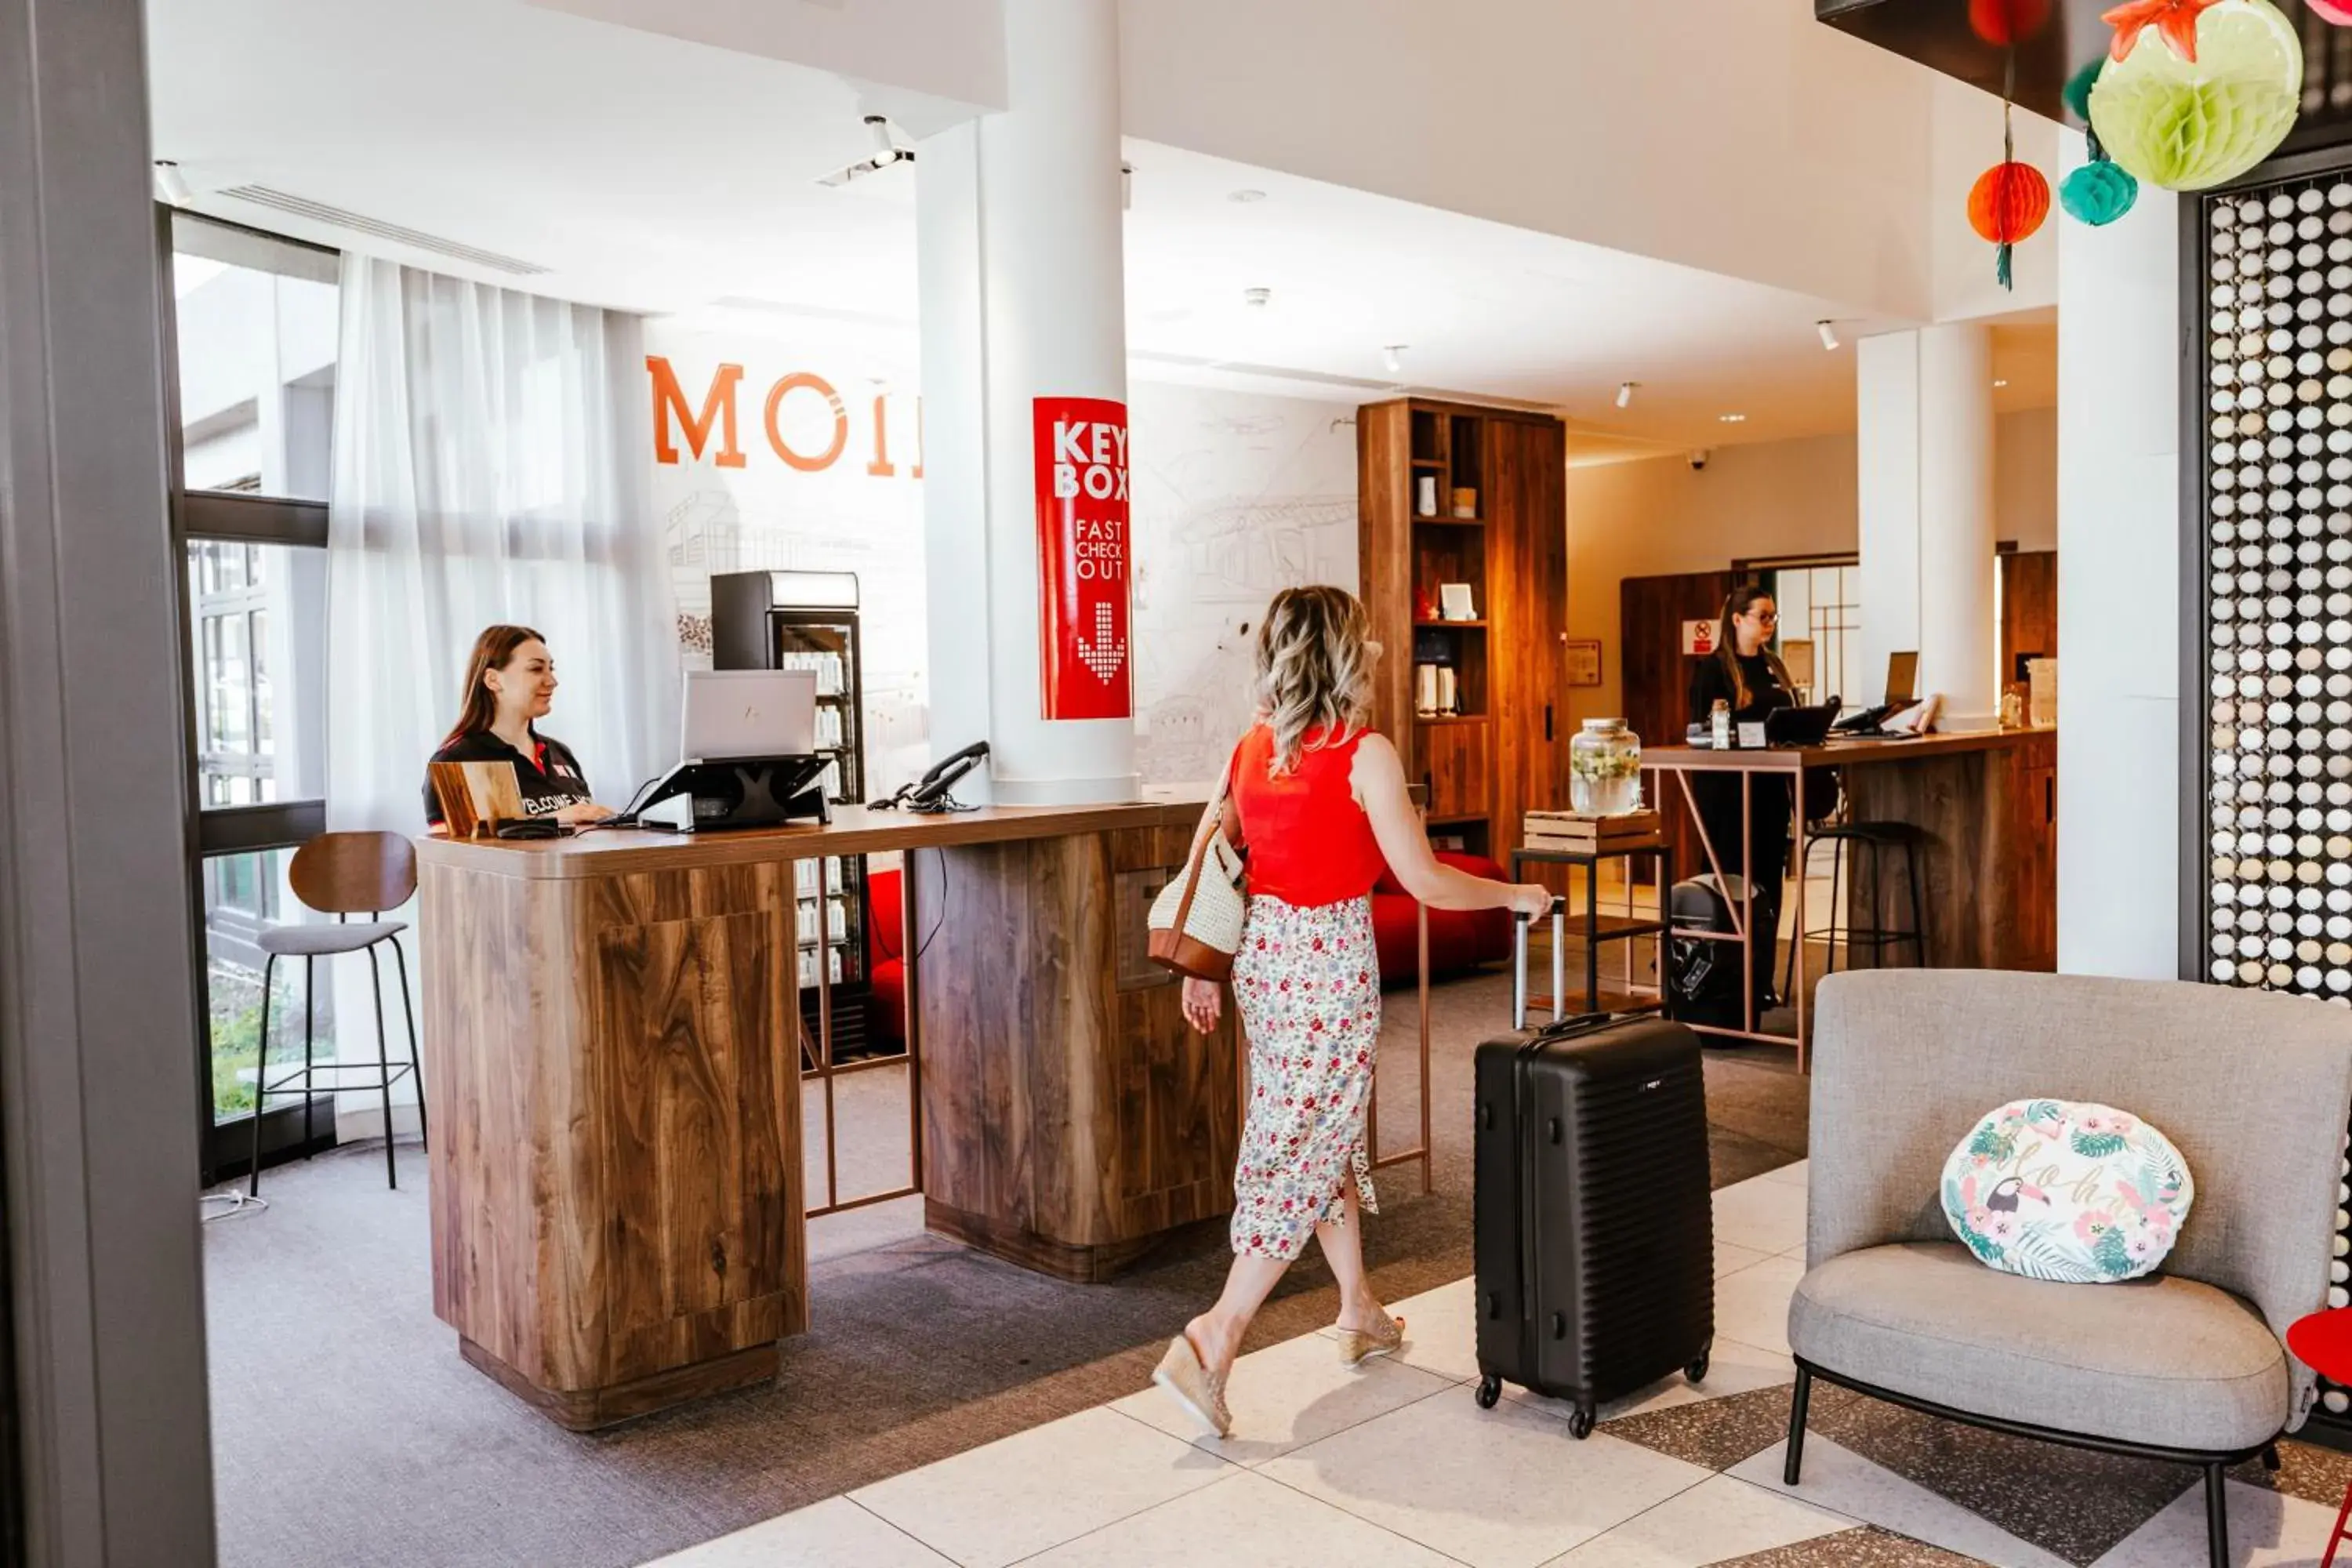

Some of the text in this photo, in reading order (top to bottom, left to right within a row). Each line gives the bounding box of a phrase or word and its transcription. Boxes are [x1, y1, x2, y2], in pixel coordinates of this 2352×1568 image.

[646, 354, 924, 479] MOI
[1053, 421, 1127, 466] KEY
[1054, 463, 1129, 502] BOX
[1076, 519, 1122, 540] FAST
[1076, 541, 1122, 559] CHECK
[1076, 560, 1122, 580] OUT
